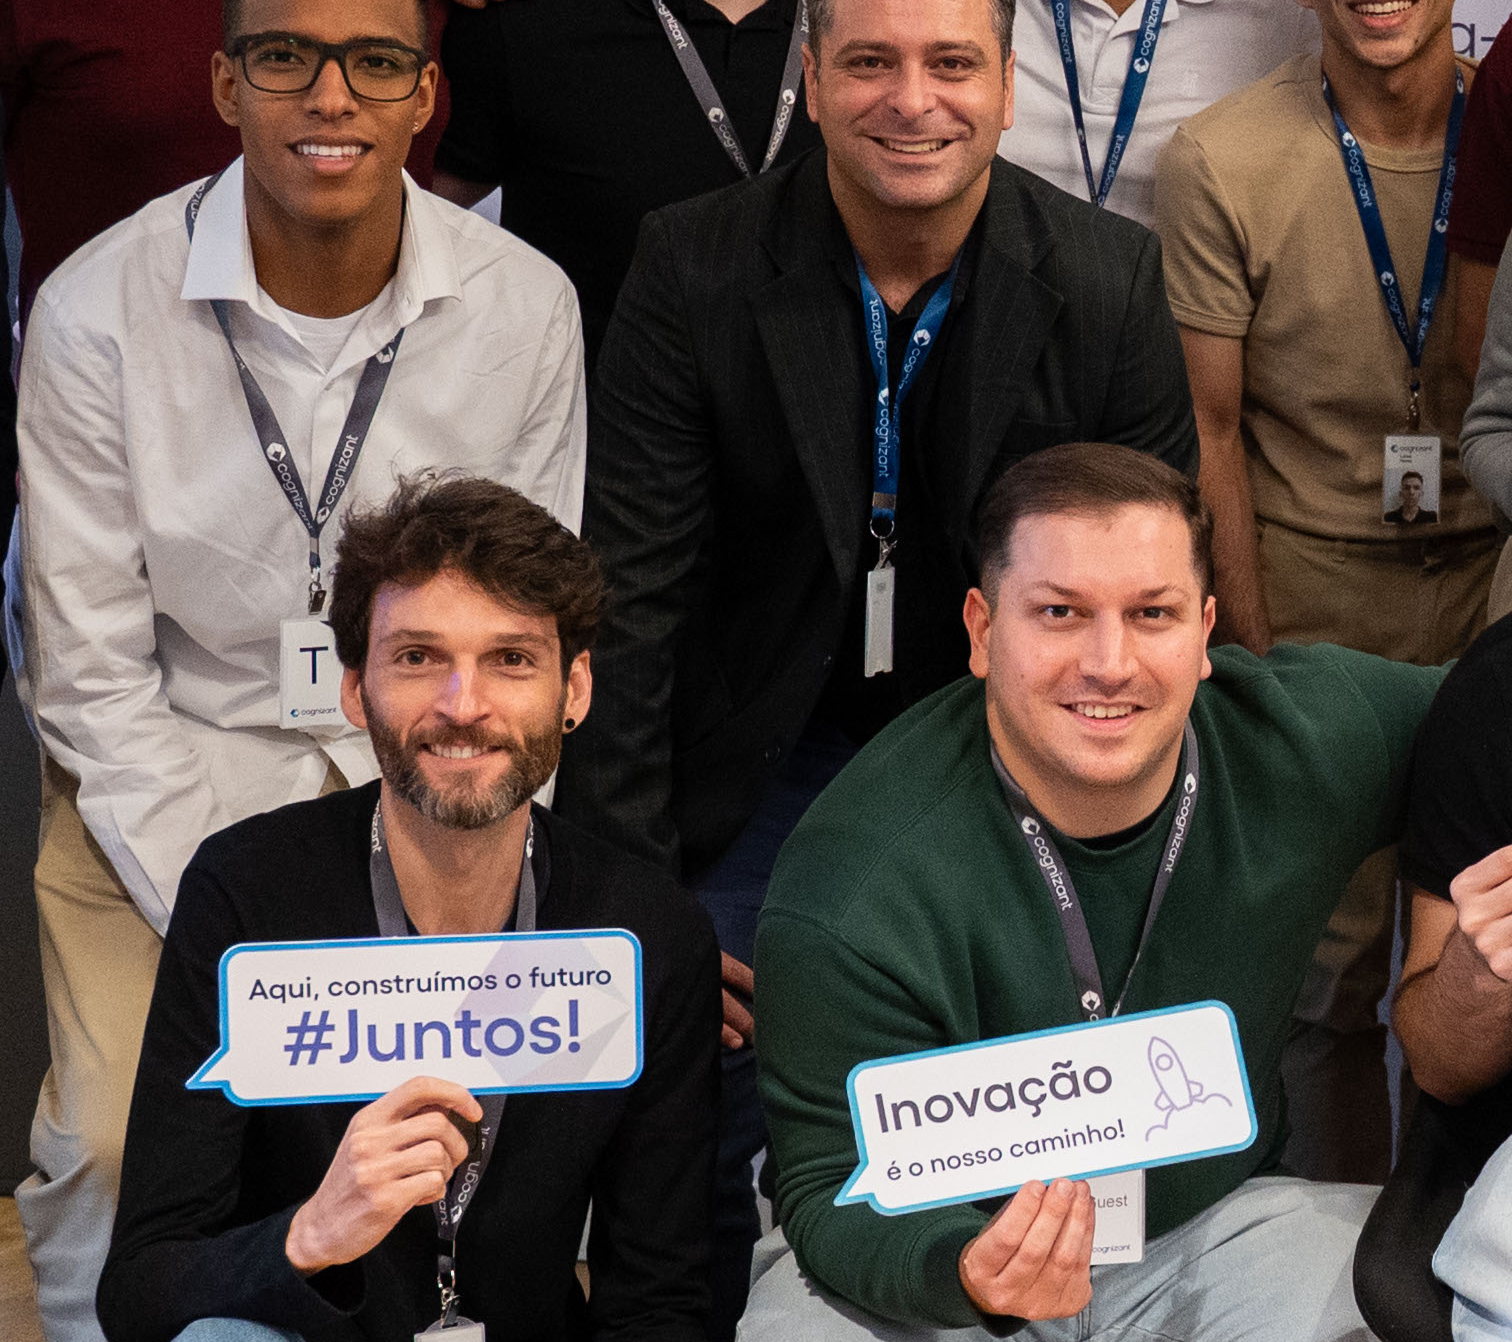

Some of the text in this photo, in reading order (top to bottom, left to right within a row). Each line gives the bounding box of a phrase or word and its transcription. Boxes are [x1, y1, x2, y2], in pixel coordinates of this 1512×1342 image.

[1055, 2, 1073, 65] cognizant
[719, 123, 751, 178] cognizan
[1348, 149, 1373, 209] cognizant
[325, 434, 359, 505] cognizant
[875, 409, 891, 478] cognizant
[277, 463, 314, 530] cognizant
[299, 645, 329, 685] T
[1164, 796, 1191, 873] cognizant
[1033, 836, 1074, 912] cognizant
[248, 965, 613, 1005] Aqui, construímos o futuro
[283, 998, 582, 1067] #Juntos!
[874, 1059, 1113, 1134] Inovação
[886, 1118, 1127, 1181] é o nosso caminho!
[1094, 1195, 1128, 1209] uest
